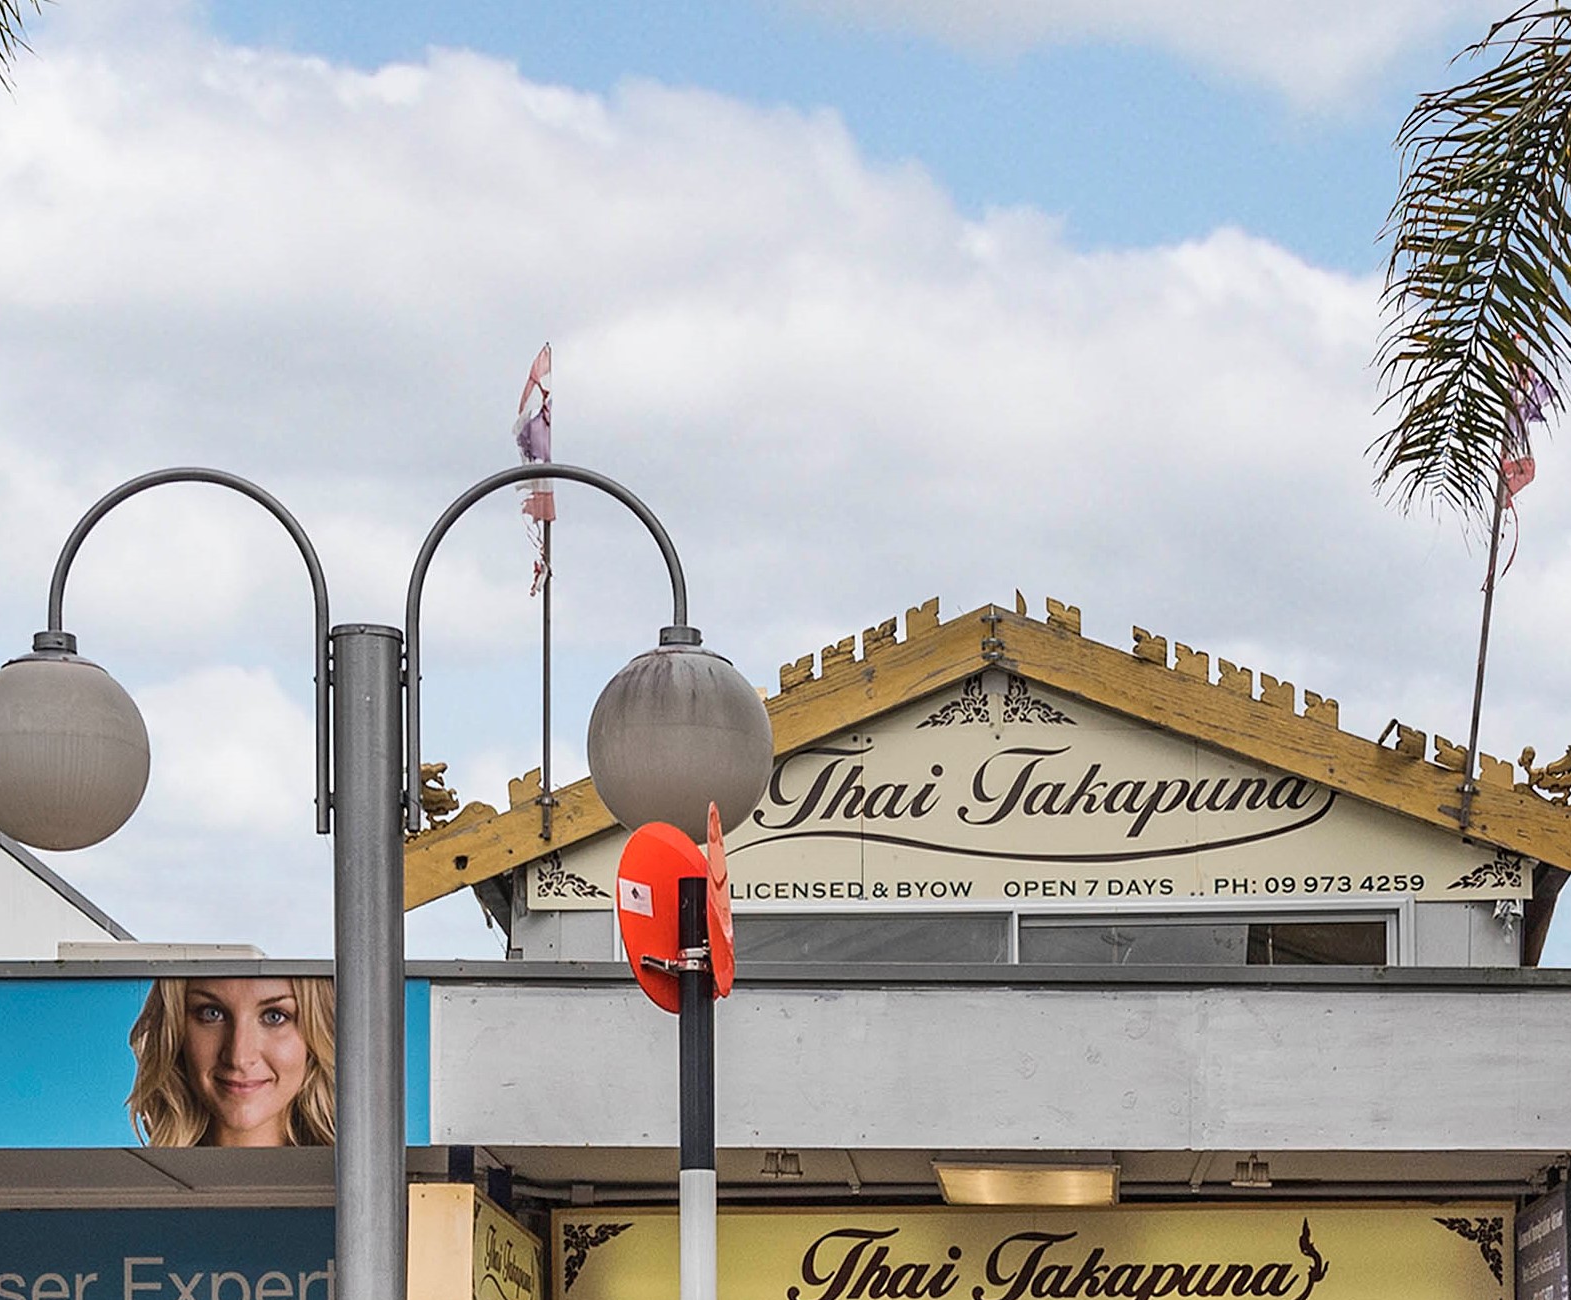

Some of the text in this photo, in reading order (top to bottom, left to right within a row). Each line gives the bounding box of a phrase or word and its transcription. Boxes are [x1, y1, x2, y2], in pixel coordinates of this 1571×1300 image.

[753, 745, 1317, 837] Thai Takapuna
[729, 875, 1425, 899] LICENSED & BYOW OPEN 7 DAYS PH: 09 973 4259
